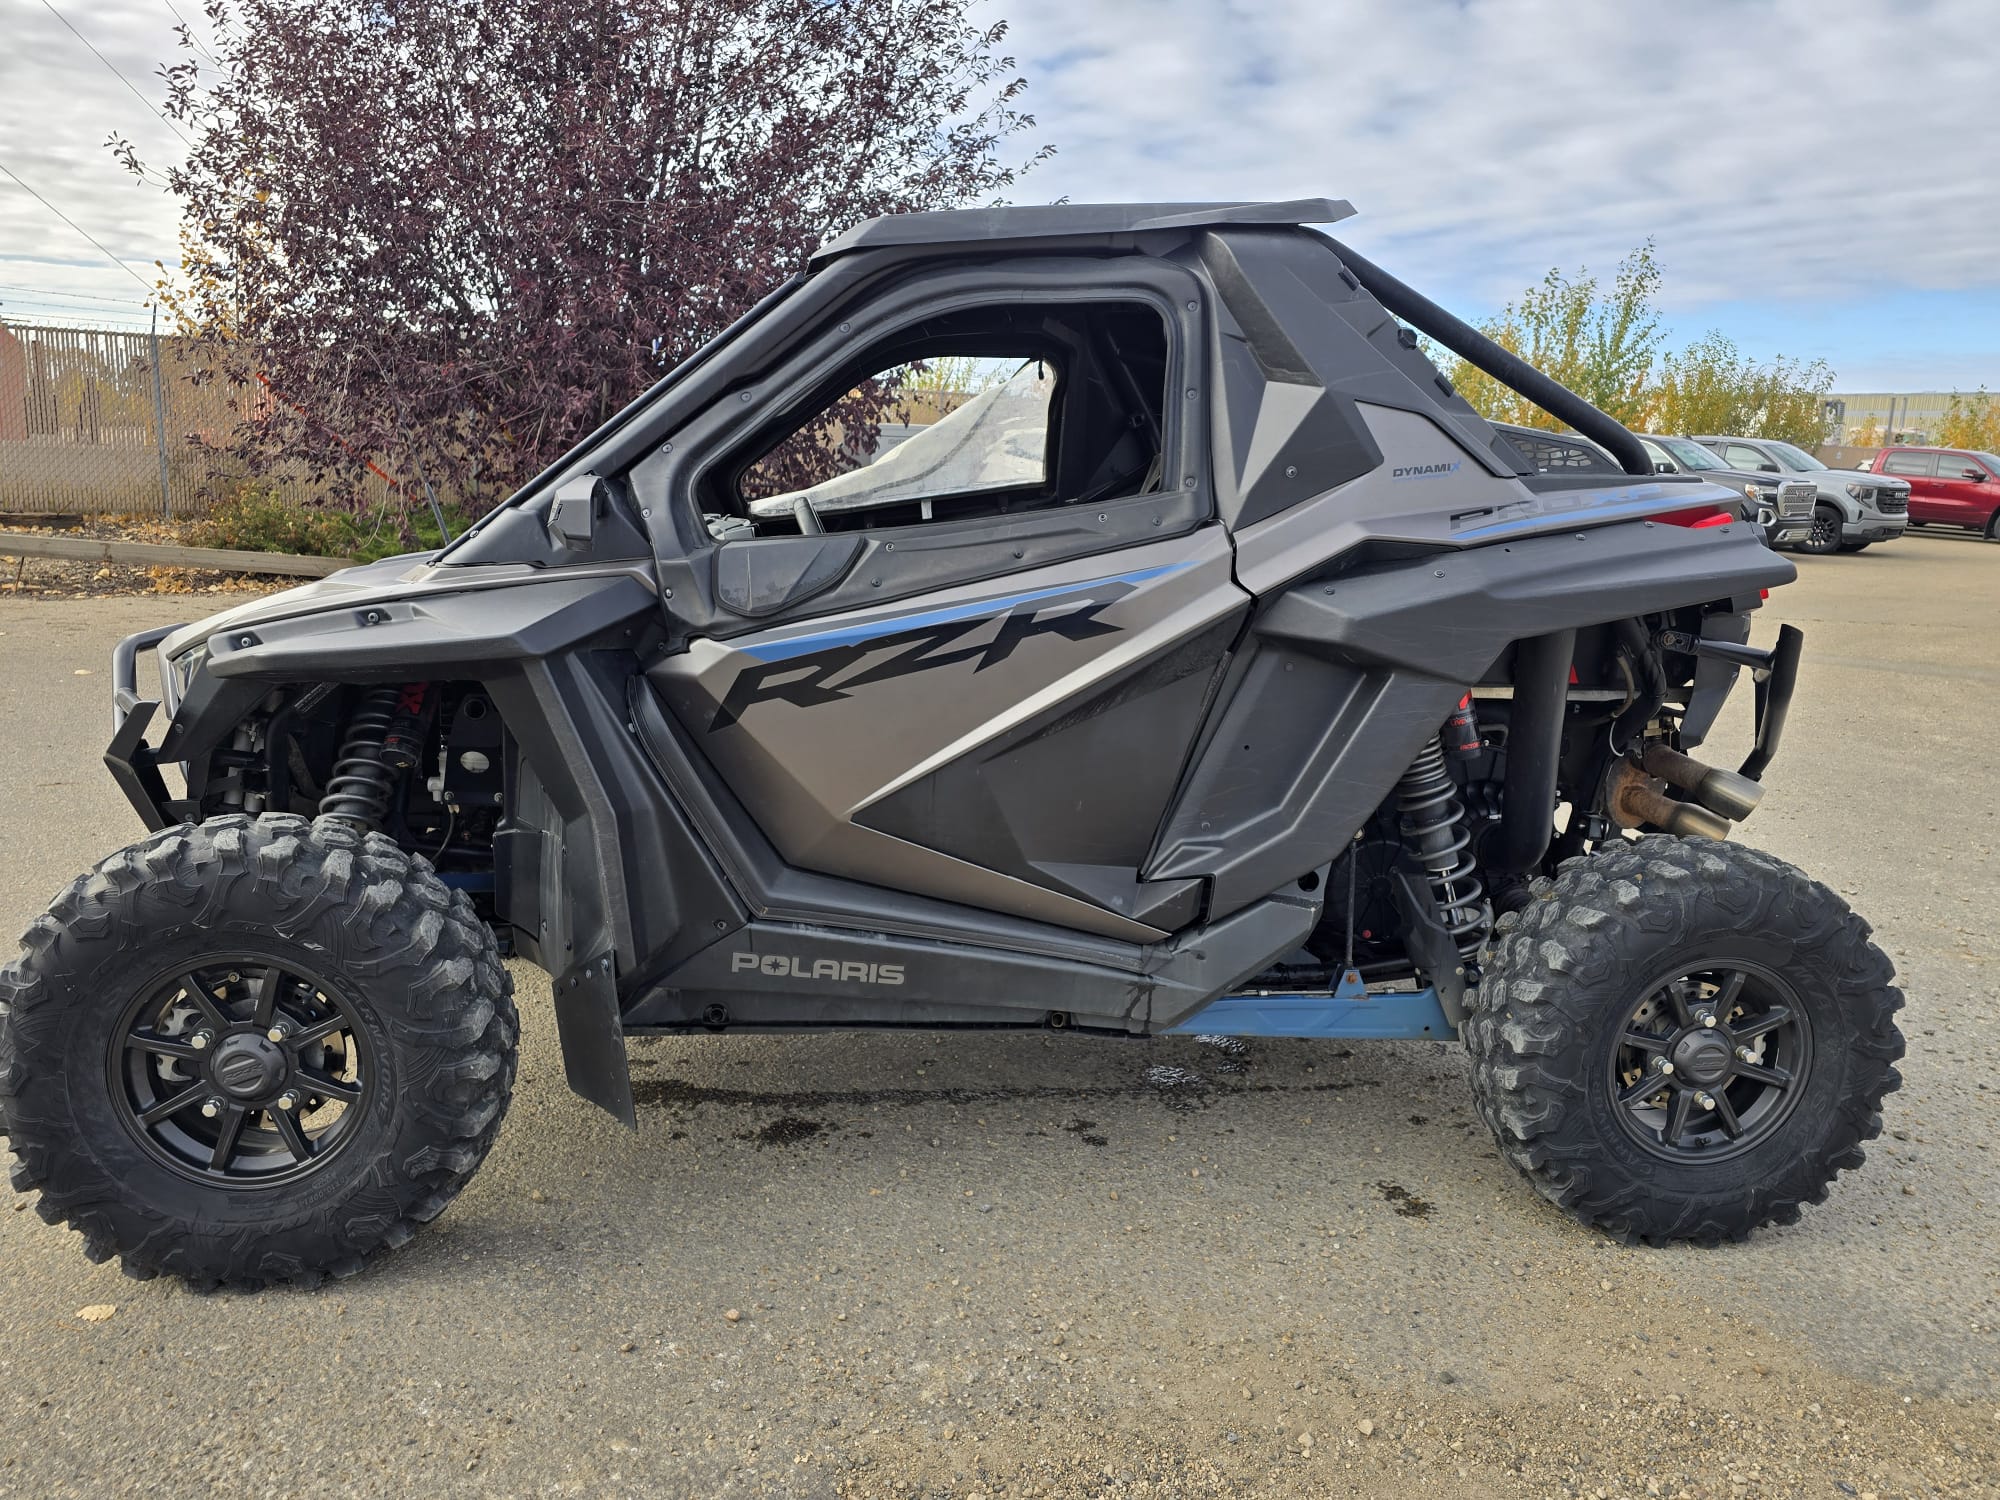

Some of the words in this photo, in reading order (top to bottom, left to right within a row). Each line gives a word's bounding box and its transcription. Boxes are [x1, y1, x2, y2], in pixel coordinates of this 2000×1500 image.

[1392, 459, 1461, 478] DYNAMIX
[707, 580, 1138, 734] RZR
[731, 951, 905, 985] POLARIS
[334, 976, 392, 1115] CARNIVORE
